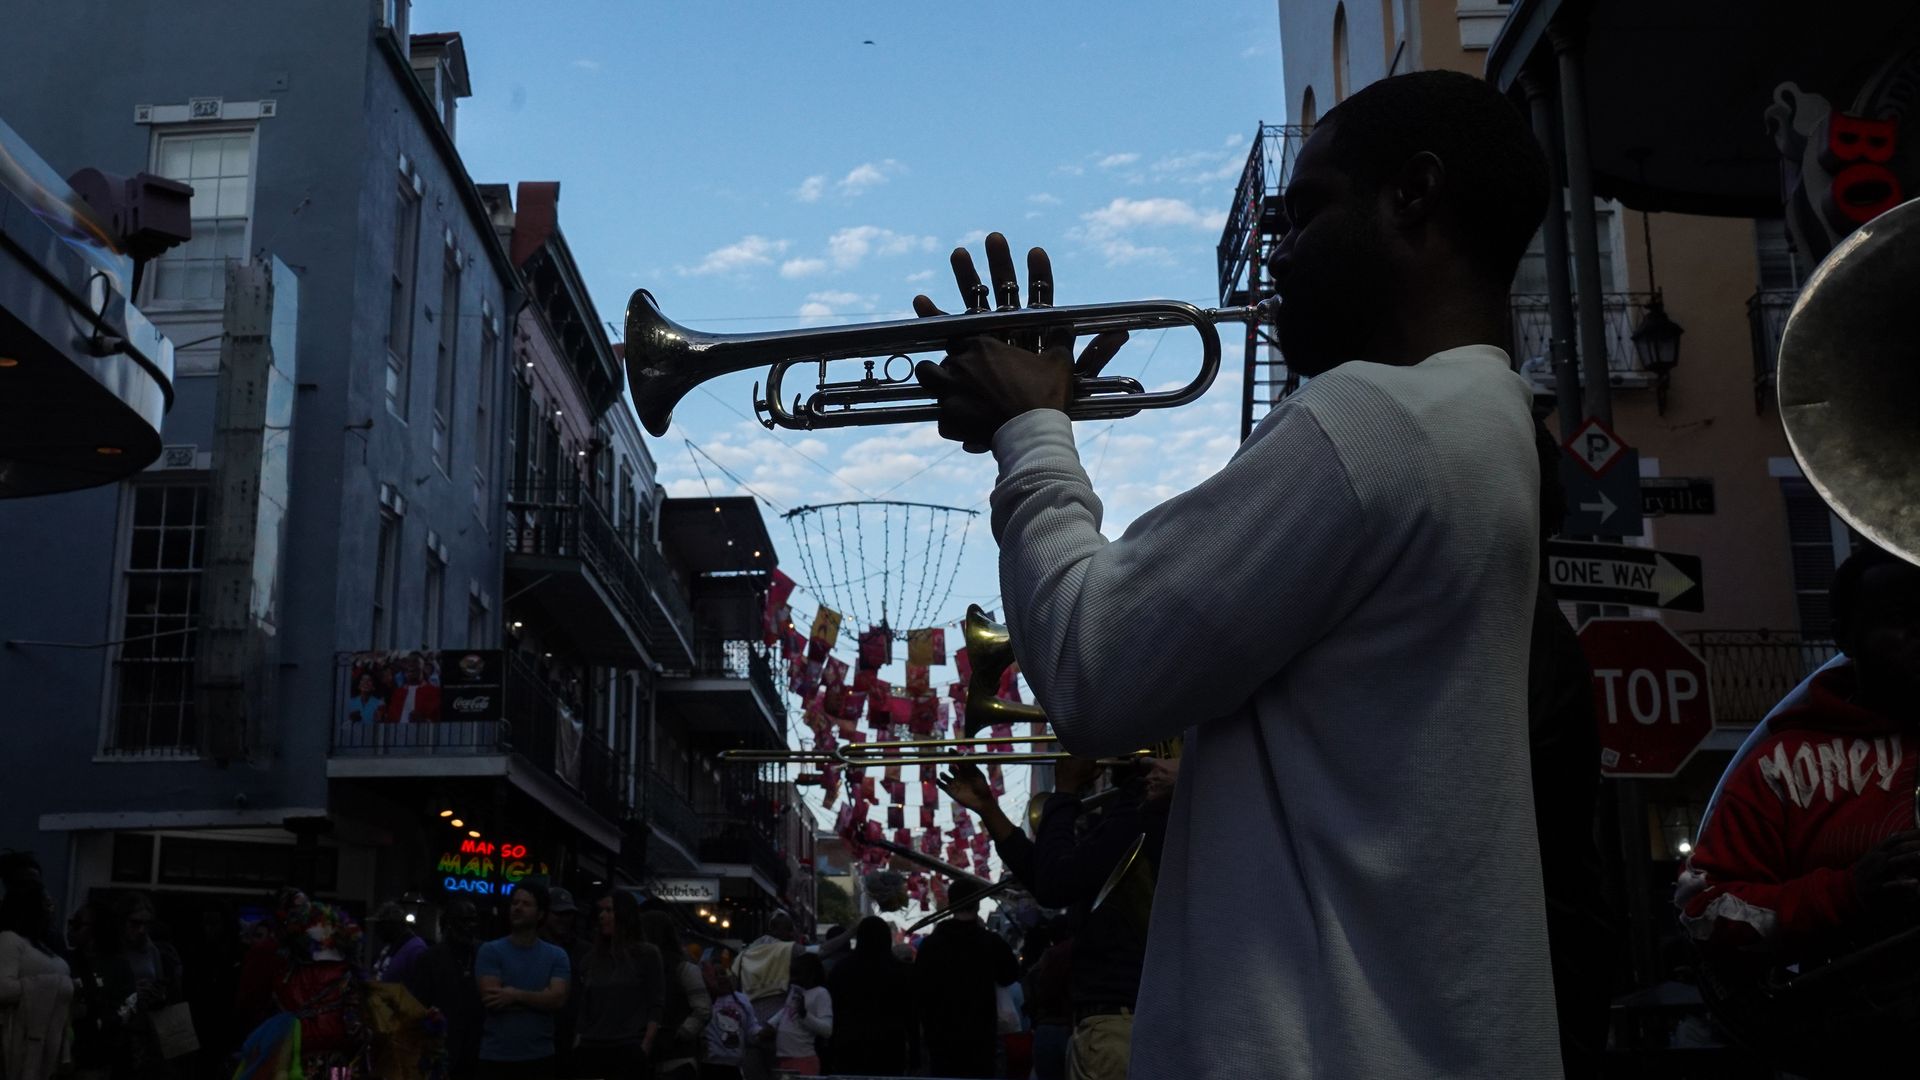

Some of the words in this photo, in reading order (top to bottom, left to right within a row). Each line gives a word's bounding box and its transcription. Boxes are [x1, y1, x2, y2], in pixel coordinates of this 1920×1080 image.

[1644, 490, 1709, 510] rville
[1555, 560, 1603, 585] ONE
[1611, 563, 1655, 589] WAY
[1593, 667, 1700, 725] TOP
